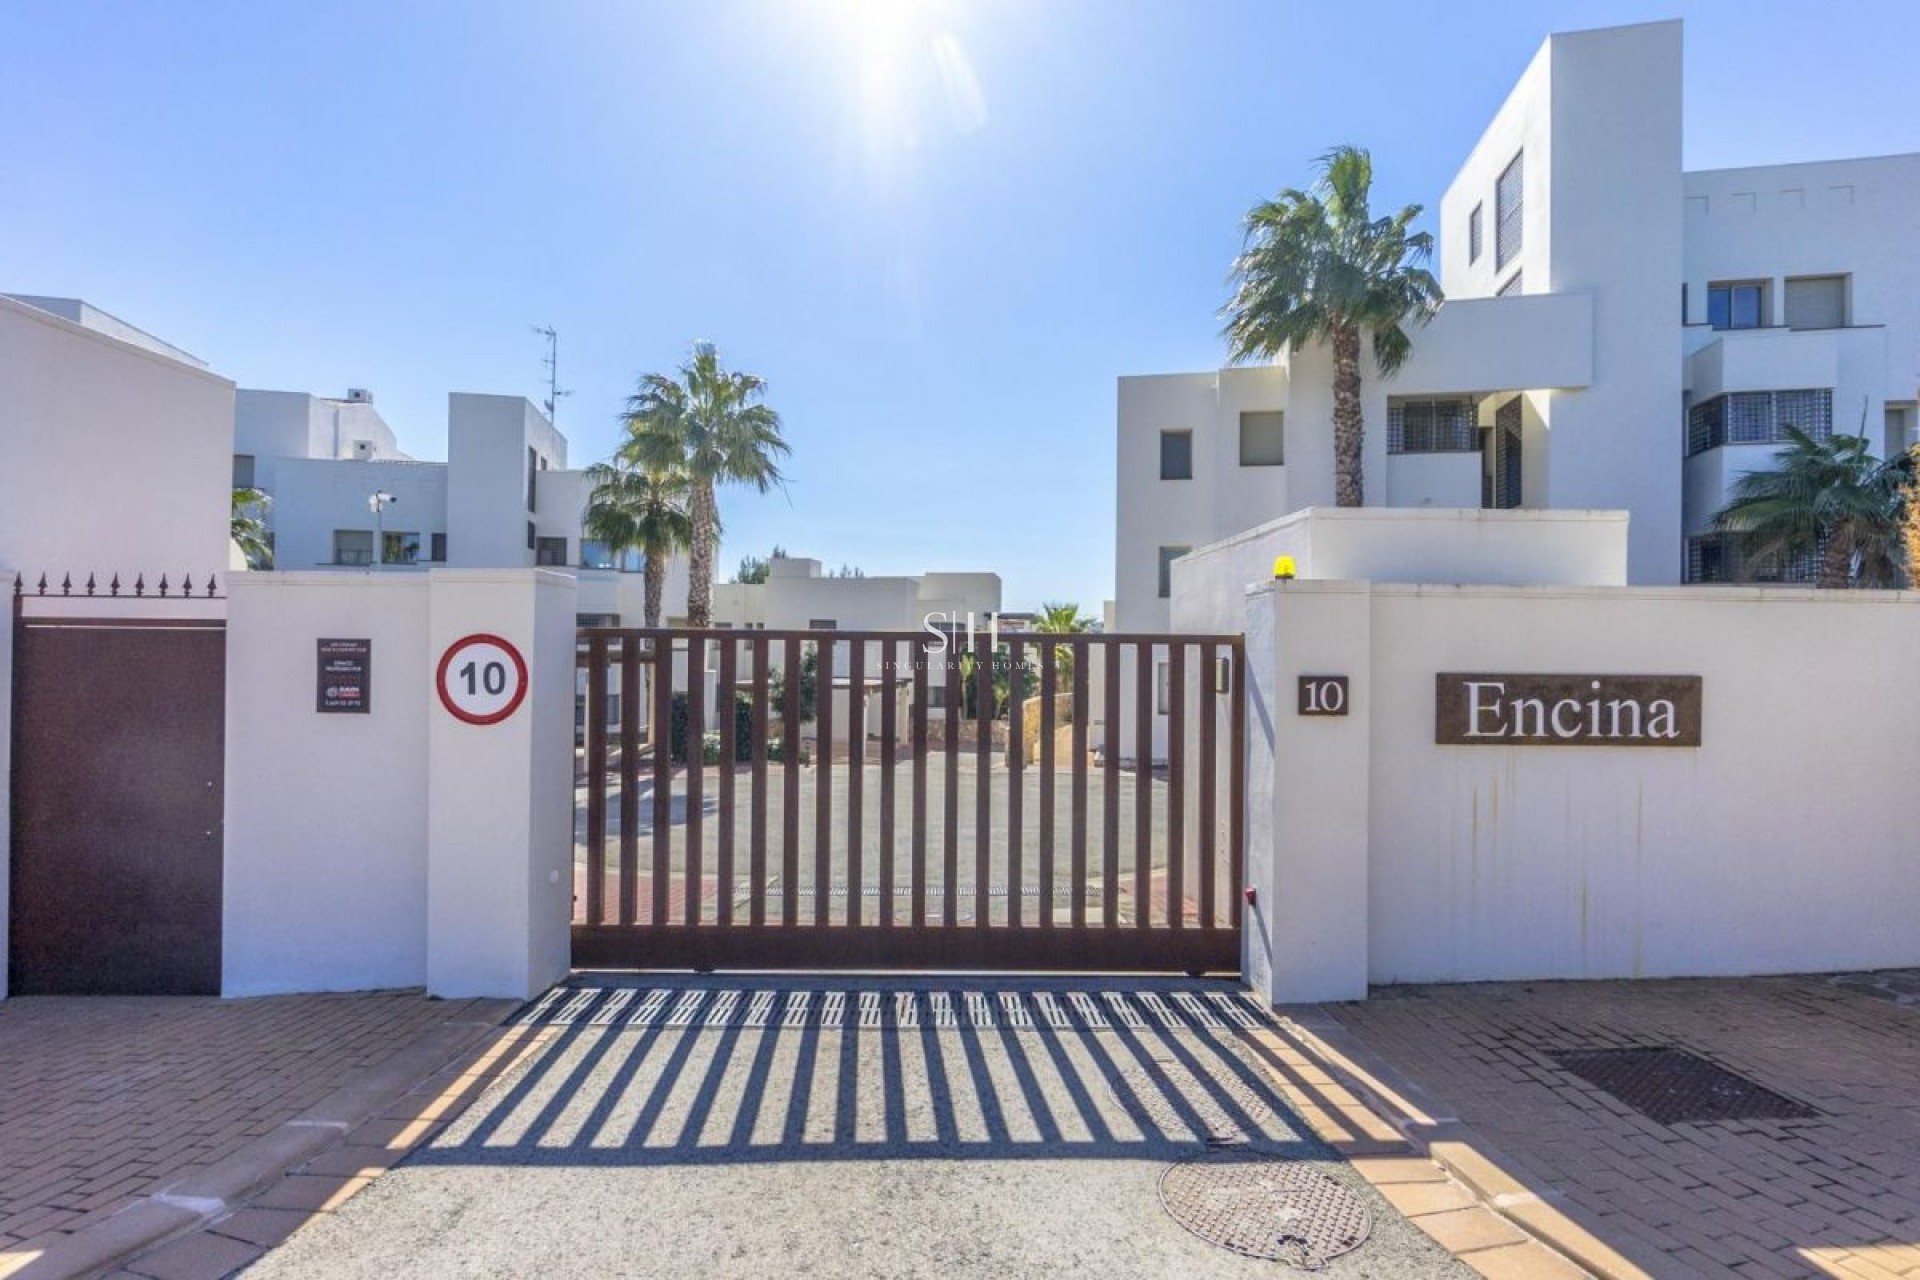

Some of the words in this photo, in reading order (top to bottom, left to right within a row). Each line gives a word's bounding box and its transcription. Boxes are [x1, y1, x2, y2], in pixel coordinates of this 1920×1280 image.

[460, 661, 506, 695] 10
[1305, 681, 1343, 711] 10
[1462, 680, 1680, 738] Encina
